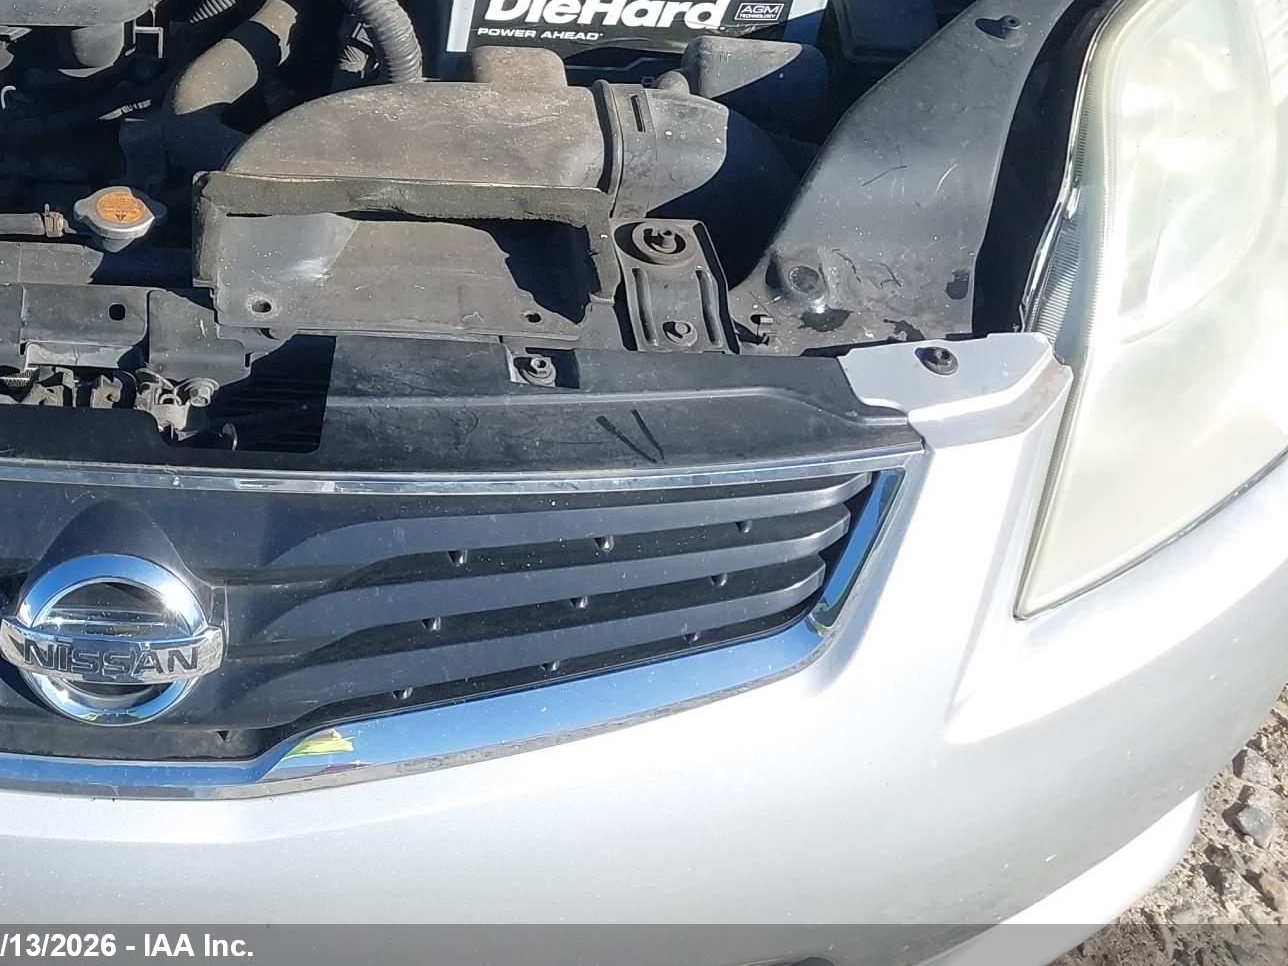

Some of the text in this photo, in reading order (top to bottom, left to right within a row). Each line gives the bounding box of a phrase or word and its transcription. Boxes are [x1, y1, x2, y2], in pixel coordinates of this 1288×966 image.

[740, 5, 781, 14] AGM
[476, 27, 601, 41] POWER AHEAD
[23, 637, 199, 676] NISSAN
